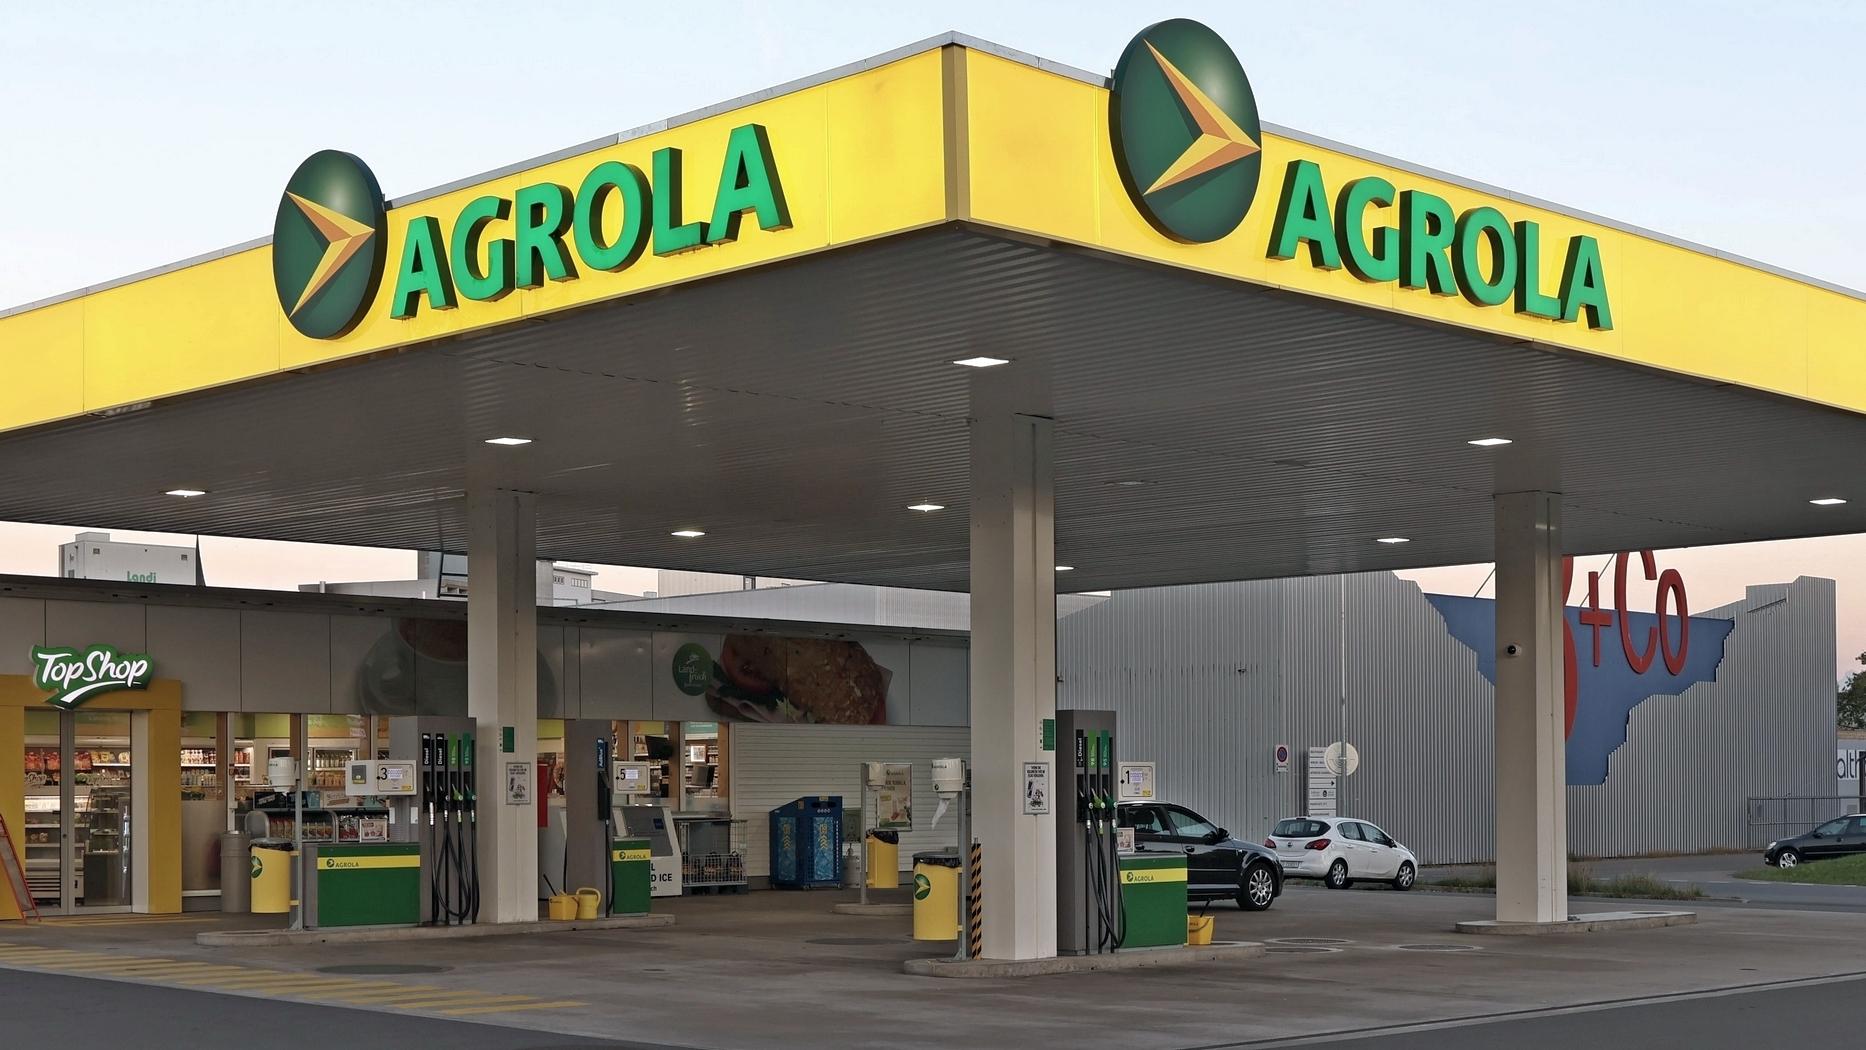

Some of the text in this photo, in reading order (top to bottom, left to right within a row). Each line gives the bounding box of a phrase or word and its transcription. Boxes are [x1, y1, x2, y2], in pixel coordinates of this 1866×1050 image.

[390, 123, 793, 321] AGROLA
[1265, 159, 1614, 332] AGROLA
[380, 767, 388, 780] 3
[620, 768, 626, 781] 5
[1125, 770, 1130, 785] 1
[659, 873, 673, 882] ICE
